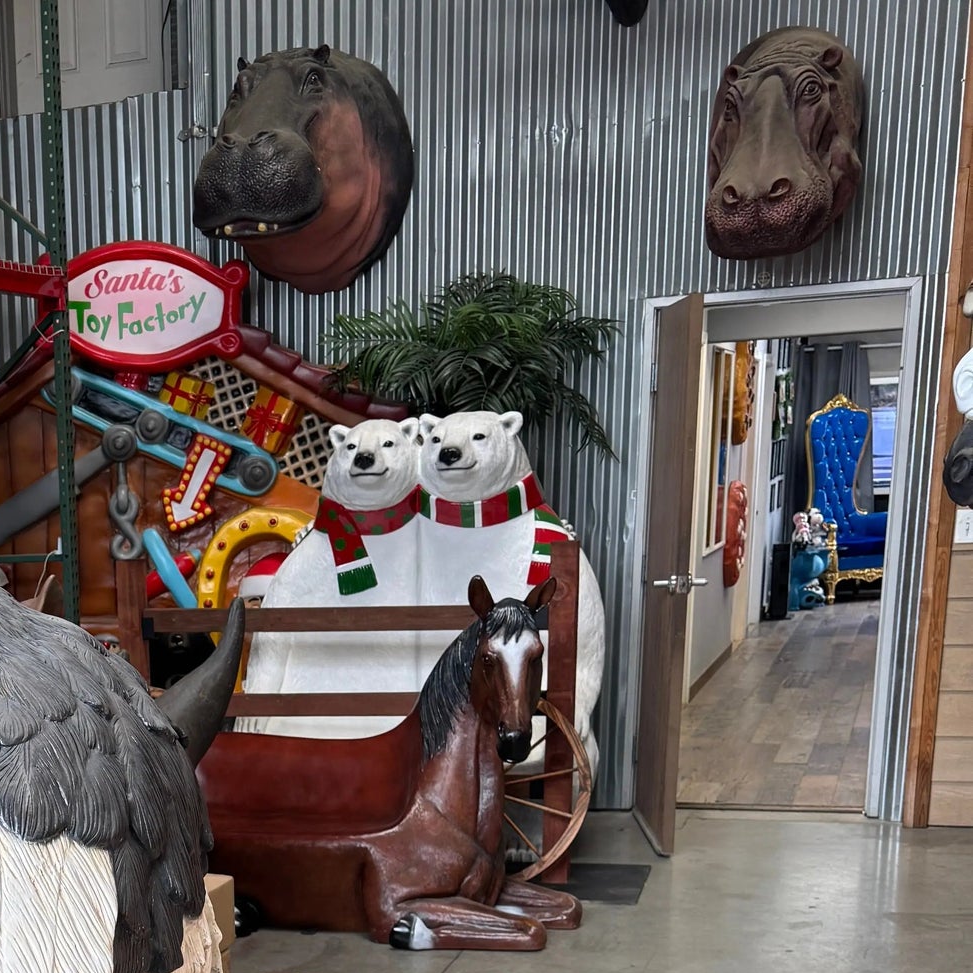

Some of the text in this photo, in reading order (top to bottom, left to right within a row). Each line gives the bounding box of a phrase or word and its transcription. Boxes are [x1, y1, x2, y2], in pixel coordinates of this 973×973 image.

[84, 267, 185, 299] Santa's
[68, 292, 207, 341] Toy Factory
